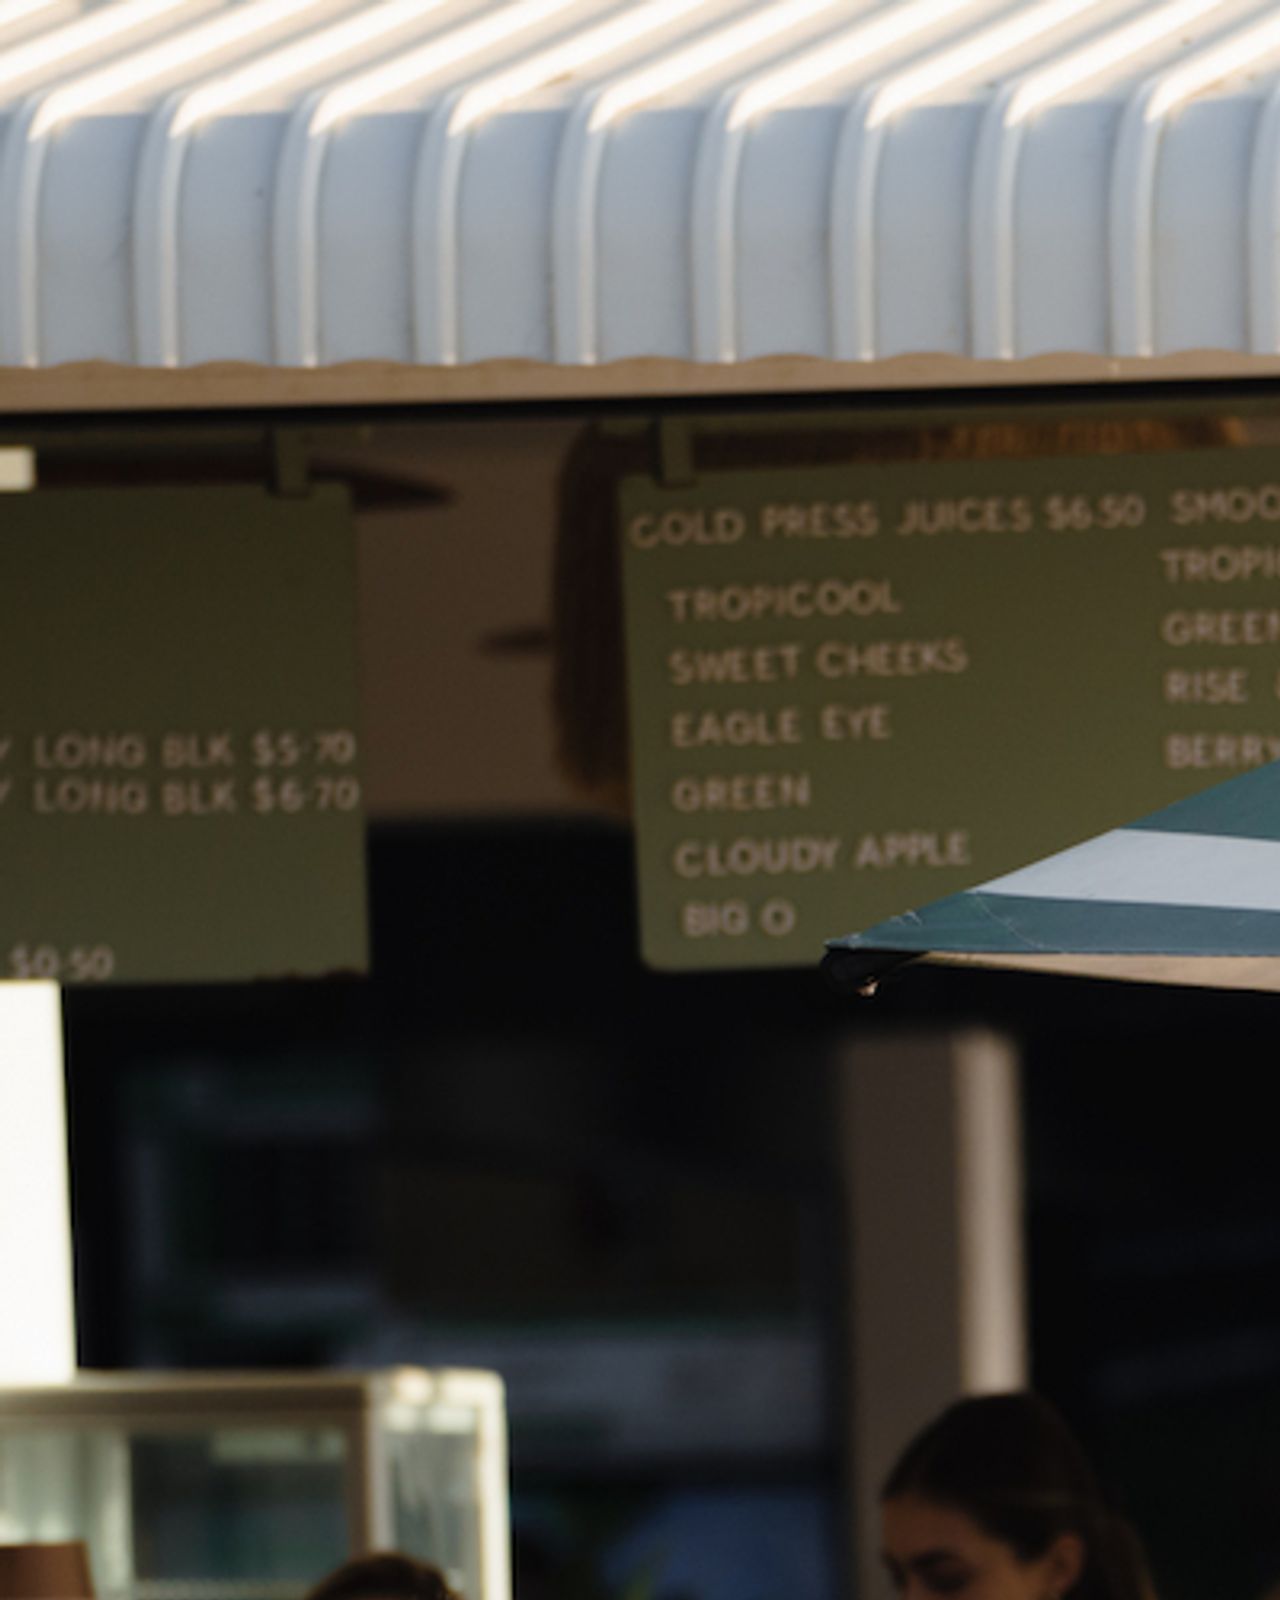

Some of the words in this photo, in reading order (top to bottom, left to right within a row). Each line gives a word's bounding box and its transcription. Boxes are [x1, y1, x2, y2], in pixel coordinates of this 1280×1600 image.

[632, 512, 744, 548] COLD
[762, 505, 880, 540] PRESS
[900, 497, 1032, 535] JUICES
[668, 581, 902, 622] TROPICOOL
[669, 646, 802, 684] SWEET
[816, 638, 968, 678] CHEEKS
[1163, 668, 1248, 703] RISE
[671, 712, 800, 747] EAGLE
[821, 706, 892, 741] EYE
[33, 733, 147, 768] LONG
[162, 732, 234, 768] BLK
[33, 779, 148, 814] LONG
[162, 779, 236, 816] BLK
[671, 774, 811, 812] GREEN
[674, 838, 840, 878] CLOUDY
[856, 831, 970, 867] APPLE
[682, 903, 750, 938] BIG
[760, 900, 794, 937] O
